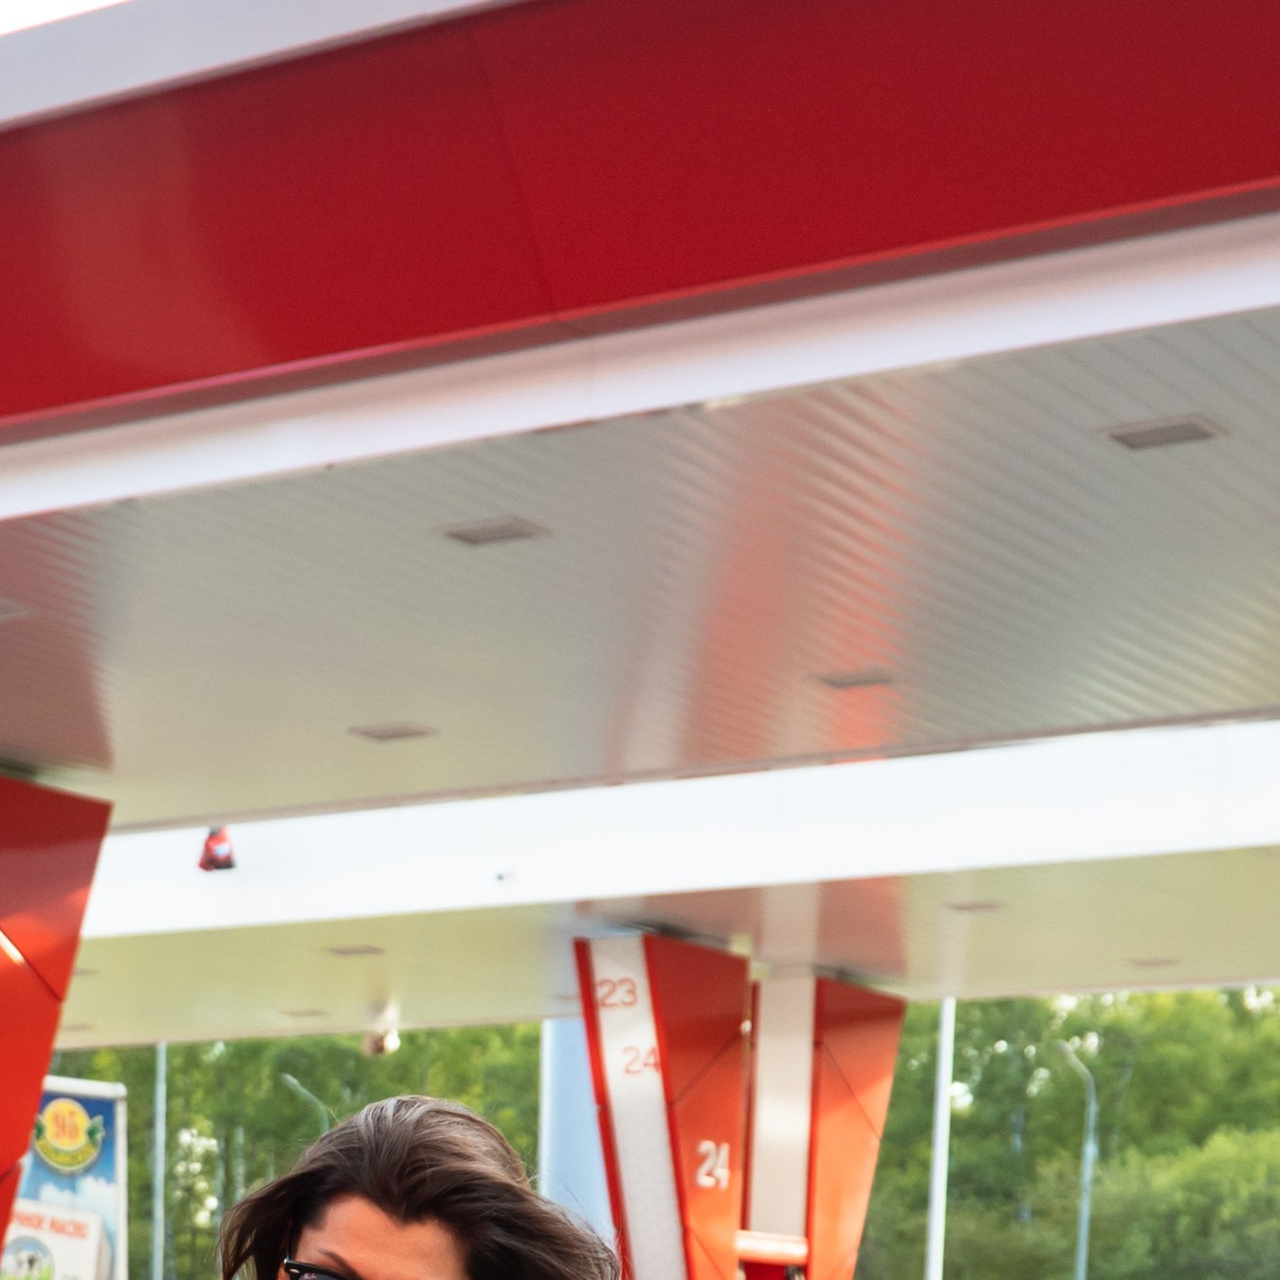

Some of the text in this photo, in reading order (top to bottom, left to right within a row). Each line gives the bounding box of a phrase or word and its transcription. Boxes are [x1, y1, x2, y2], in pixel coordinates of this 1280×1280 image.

[597, 978, 638, 1009] 23
[622, 1045, 661, 1075] 24
[696, 1140, 730, 1191] 24
